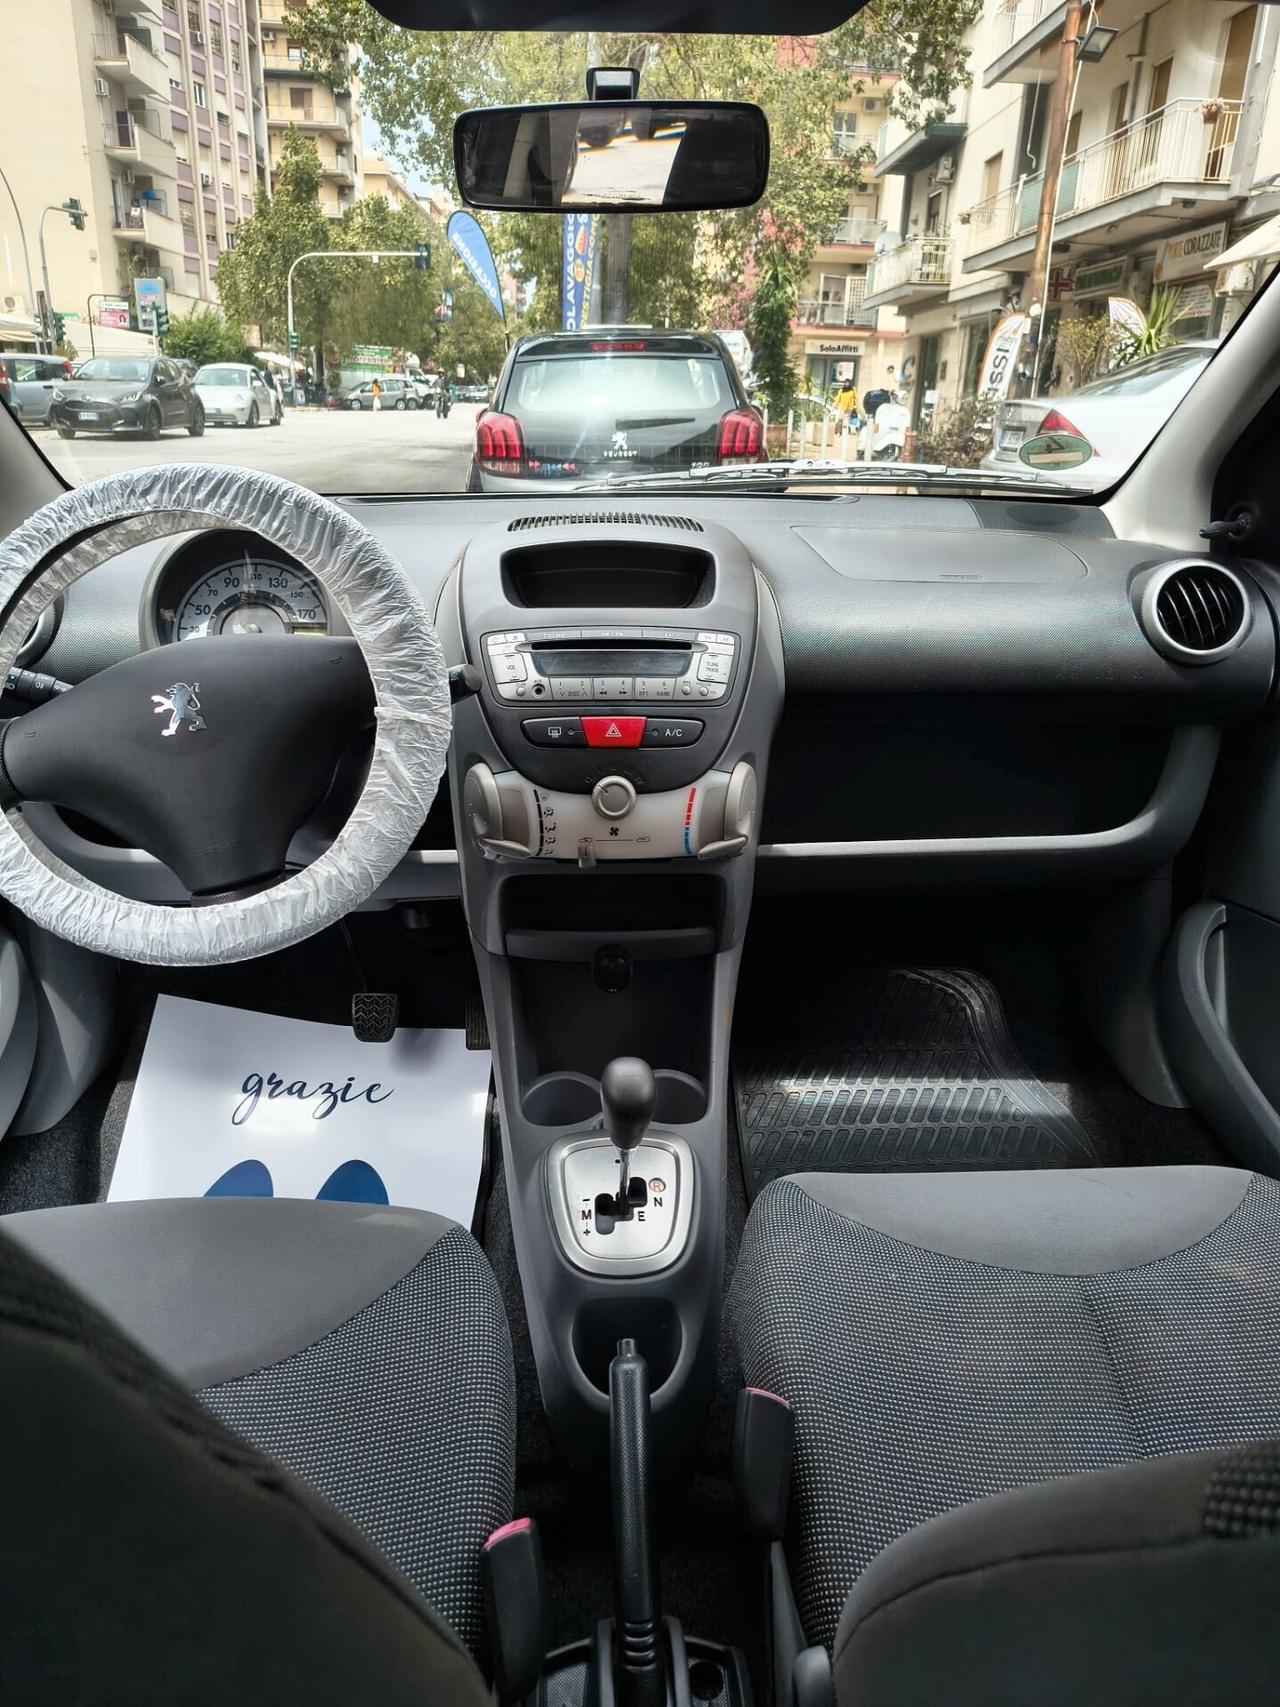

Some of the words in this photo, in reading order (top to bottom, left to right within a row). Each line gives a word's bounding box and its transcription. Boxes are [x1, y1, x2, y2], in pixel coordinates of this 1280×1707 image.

[224, 577, 240, 588] 90
[268, 578, 288, 588] 130
[207, 589, 219, 597] 70
[195, 604, 211, 616] 50
[298, 609, 316, 620] 170
[665, 728, 682, 737] A/C
[231, 1071, 395, 1126] grazie
[653, 1197, 663, 1207] N
[581, 1209, 592, 1221] M
[637, 1211, 646, 1222] E
